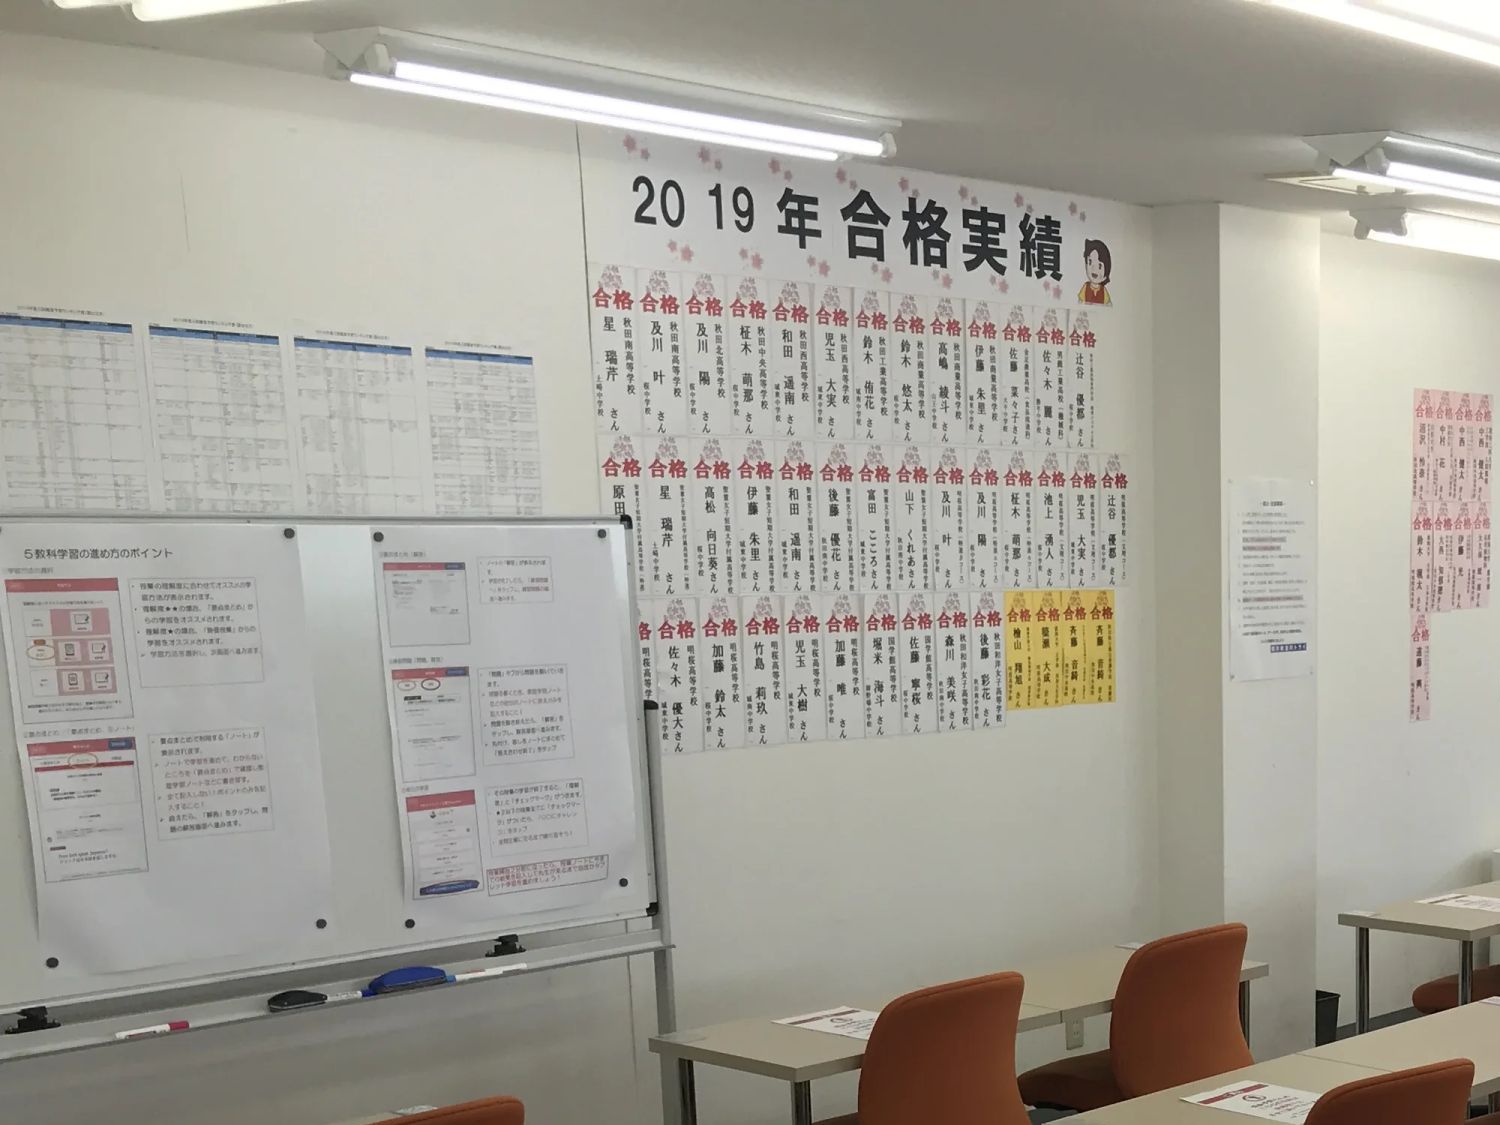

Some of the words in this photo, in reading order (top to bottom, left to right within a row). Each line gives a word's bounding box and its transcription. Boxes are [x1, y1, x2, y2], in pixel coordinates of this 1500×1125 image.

[593, 287, 634, 310] 合格
[640, 291, 680, 315] 合格
[686, 293, 723, 317] 合格
[730, 295, 767, 320] 合格
[772, 302, 809, 324] 合格
[816, 305, 849, 327] 合格
[856, 309, 888, 331] 合格
[893, 314, 925, 335] 合格
[930, 317, 962, 338] 合格
[968, 320, 997, 340] 合格
[1002, 323, 1032, 343] 合格
[1036, 325, 1065, 345] 合格
[651, 321, 663, 352] 及川
[696, 323, 708, 353] 及川
[782, 329, 793, 358] 和田
[825, 332, 835, 361] 児玉
[1069, 328, 1097, 348] 合格
[623, 317, 636, 395] 秋田南高等学校
[670, 321, 682, 398] 秋田南高等学校
[714, 323, 725, 398] 秋田北高等学校
[863, 335, 874, 364] 鈴木
[900, 339, 911, 368] 鈴木
[975, 344, 984, 372] 伊藤
[1009, 347, 1018, 373] 佐藤
[603, 316, 616, 331] 星
[610, 408, 619, 431] さん
[653, 369, 665, 384] 叶
[757, 326, 768, 410] 秋田中央高等学校
[799, 329, 809, 402] 秋田西高等学校
[840, 333, 849, 404] 秋田西高等学校
[879, 336, 888, 416] 秋田工業高等学校
[1043, 350, 1052, 390] 佐々木
[1076, 352, 1084, 380] 辻谷
[699, 370, 710, 386] 陽
[742, 373, 753, 403] 萌那
[917, 340, 925, 419] 秋田商業高等学校
[953, 343, 962, 420] 秋田商業高等学校
[826, 378, 837, 408] 大実
[902, 383, 912, 412] 悠太
[657, 411, 666, 433] さん
[702, 411, 711, 433] さん
[745, 412, 753, 434] さん
[787, 414, 795, 436] さん
[828, 416, 835, 438] さん
[866, 417, 874, 439] さん
[904, 420, 911, 442] さん
[942, 422, 949, 442] さん
[978, 423, 984, 443] さん
[1012, 425, 1018, 445] さん
[1045, 426, 1052, 446] さん
[1077, 428, 1084, 447] さん
[602, 457, 642, 477] 合格
[648, 458, 687, 478] 合格
[693, 459, 731, 480] 合格
[737, 460, 774, 480] 合格
[779, 461, 813, 481] 合格
[820, 463, 854, 482] 合格
[858, 464, 891, 482] 合格
[896, 466, 928, 484] 合格
[933, 466, 964, 485] 合格
[969, 468, 999, 486] 合格
[1003, 469, 1033, 487] 合格
[1037, 470, 1065, 487] 合格
[1070, 471, 1097, 489] 合格
[1101, 472, 1128, 489] 合格
[658, 618, 696, 640] 合格
[702, 617, 738, 637] 合格
[745, 616, 780, 636] 合格
[786, 614, 820, 634] 合格
[826, 614, 860, 633] 合格
[866, 613, 897, 632] 合格
[902, 612, 933, 630] 合格
[937, 611, 968, 629] 合格
[973, 610, 1002, 628] 合格
[754, 641, 765, 670] 竹島
[795, 639, 806, 668] 児玉
[835, 639, 846, 667] 加藤
[910, 636, 919, 663] 佐藤
[945, 635, 954, 661] 森川
[980, 633, 989, 660] 後藤
[669, 645, 682, 687] 佐々木
[712, 643, 724, 673] 加藤
[811, 639, 821, 697] 明桜高等学校
[851, 638, 860, 696] 明桜高等学校
[642, 647, 653, 699] 明桜高等学
[687, 645, 698, 706] 明桜高等学校
[730, 642, 740, 703] 明桜高等学校
[771, 640, 781, 700] 明桜高等学校
[797, 684, 808, 712] 大樹
[836, 682, 847, 696] 唯
[946, 676, 956, 703] 美咲
[672, 702, 683, 729] 優大
[877, 715, 884, 736] さん
[913, 713, 920, 733] さん
[949, 710, 956, 730] さん
[983, 708, 990, 728] さん
[717, 727, 725, 748] さん
[759, 724, 767, 745] さん
[800, 720, 808, 741] さん
[839, 718, 847, 739] さん
[674, 731, 683, 752] さん
